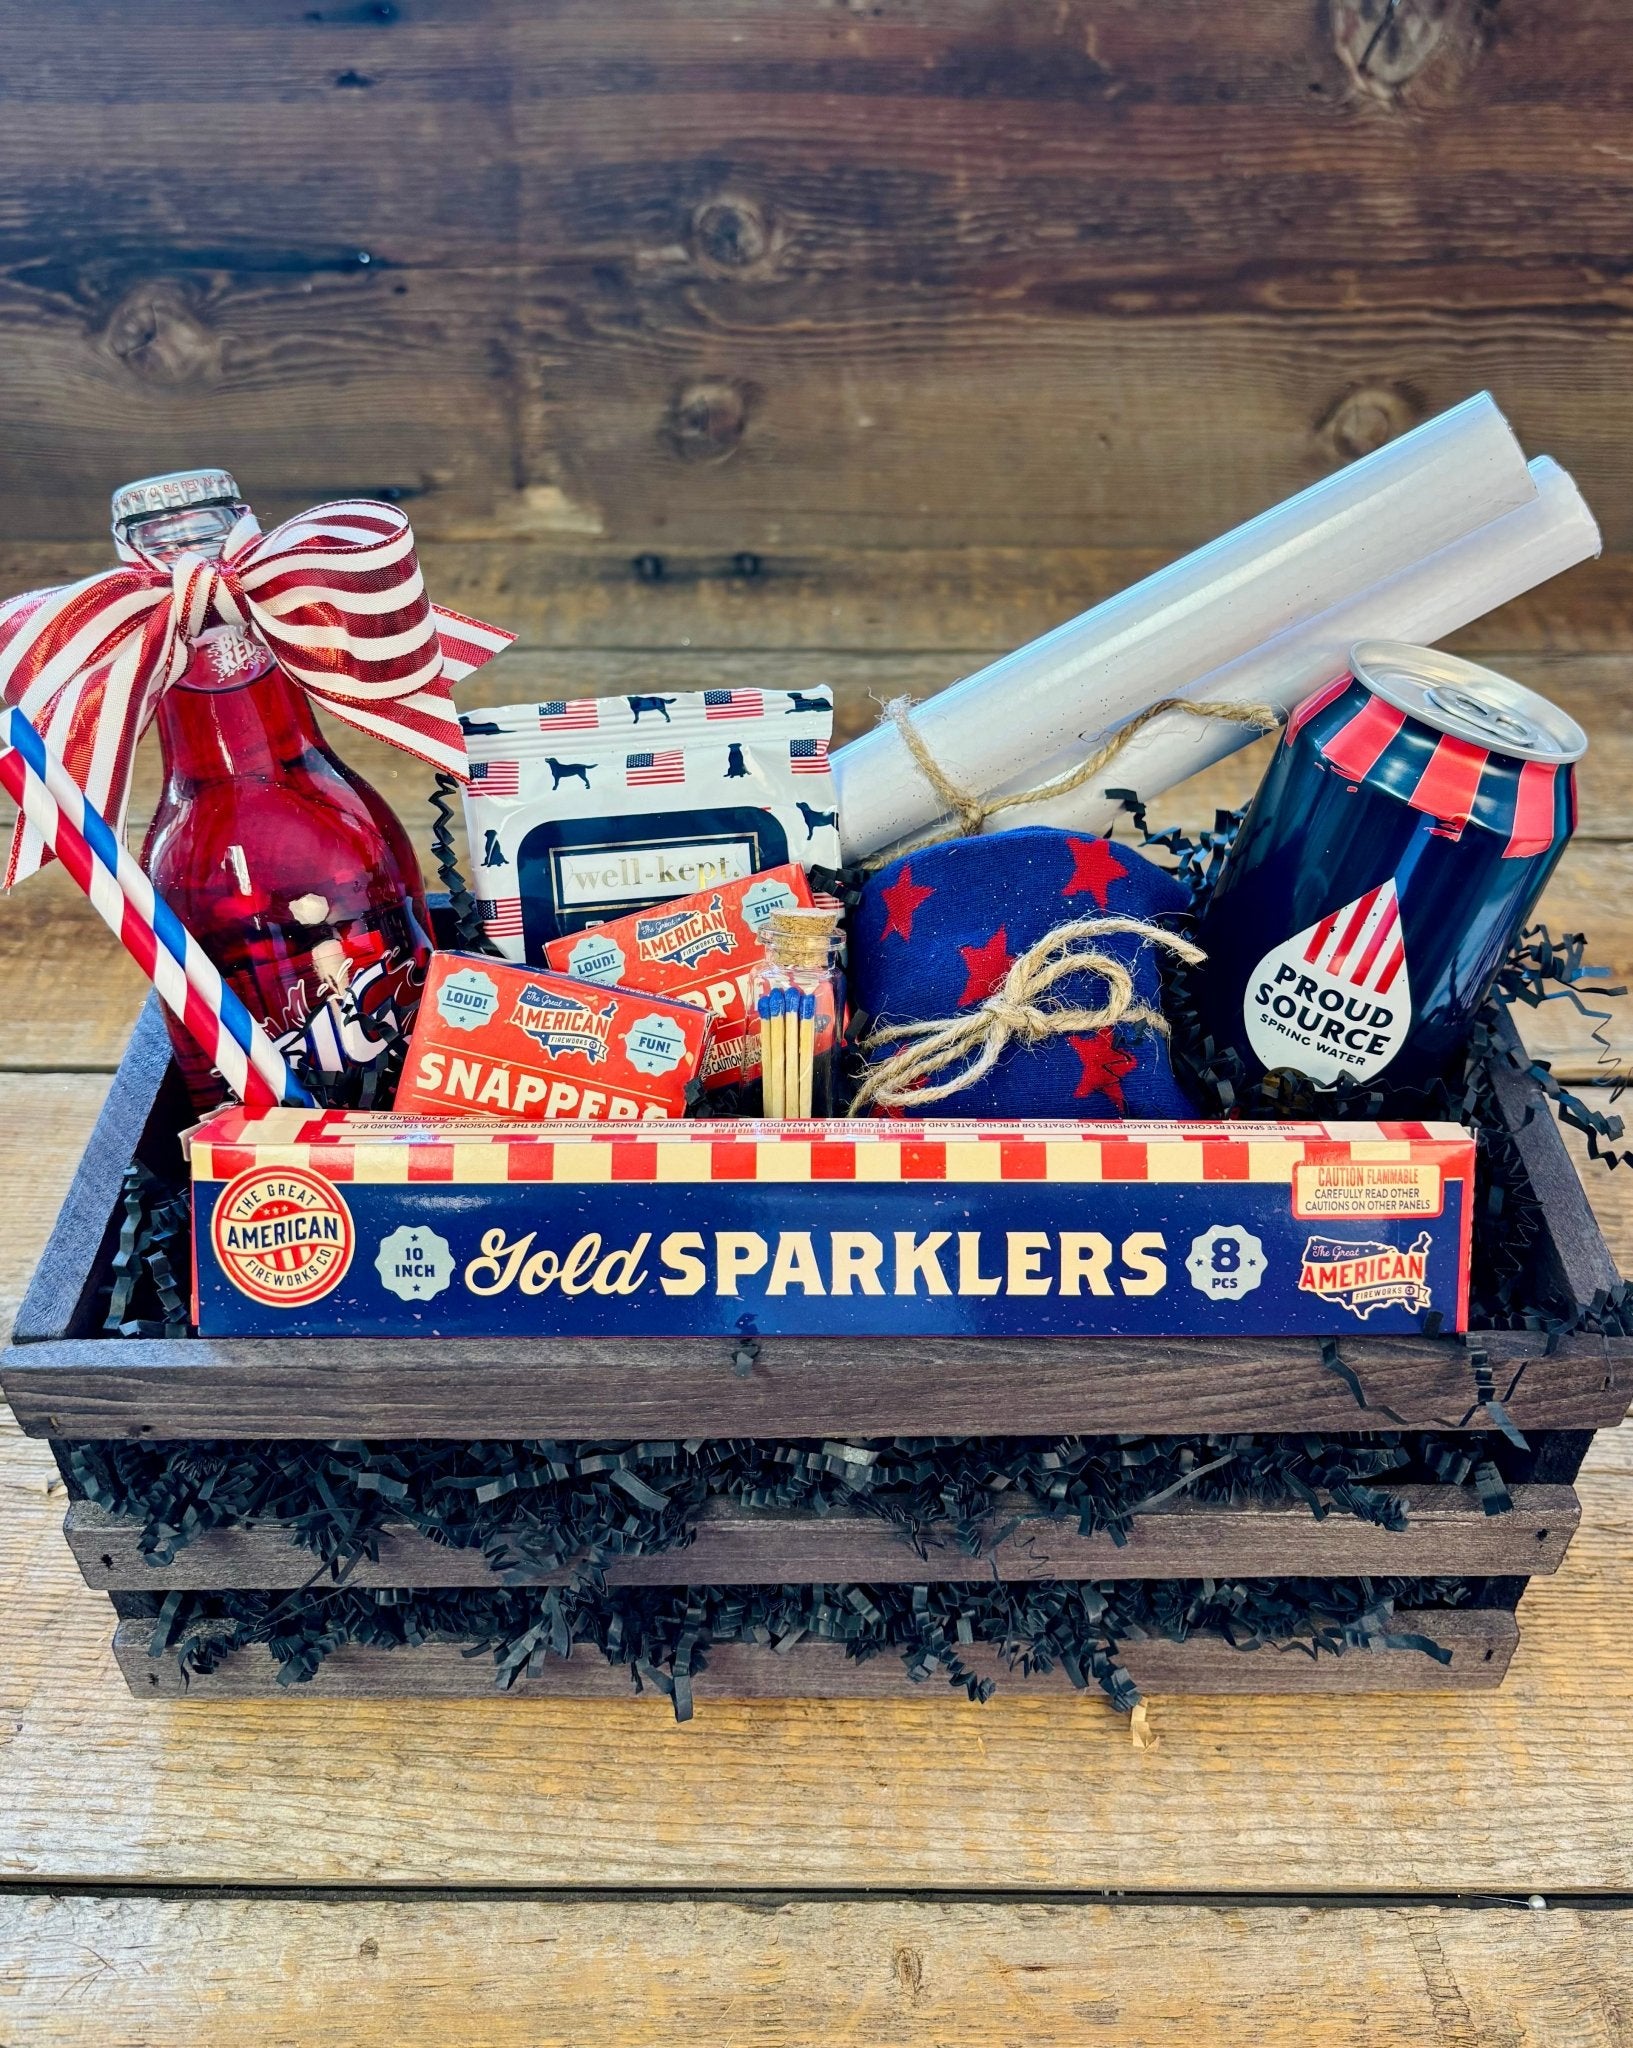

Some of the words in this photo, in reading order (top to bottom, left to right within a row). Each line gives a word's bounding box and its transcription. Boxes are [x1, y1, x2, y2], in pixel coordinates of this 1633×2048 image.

[572, 856, 740, 891] well-kept.
[754, 899, 785, 917] FUN!
[640, 911, 725, 960] AMERICAN
[641, 924, 656, 935] The
[655, 918, 675, 932] Great
[682, 937, 715, 958] FIREWORKS
[576, 954, 616, 974] LOUD!
[446, 989, 488, 1010] LOUD!
[526, 990, 540, 1002] The
[541, 994, 563, 1007] Great
[1273, 962, 1394, 1029] PROUD
[511, 1003, 609, 1039] AMERICAN
[1254, 983, 1392, 1056] SOURCE
[550, 1036, 588, 1046] FIREWORKS
[638, 1035, 671, 1053] FUN!
[1259, 1013, 1311, 1046] SPRING
[1316, 1041, 1366, 1066] WATER
[1318, 1167, 1364, 1187] CAUTION
[1367, 1168, 1419, 1185] FLAMMABLE
[236, 1190, 261, 1216] THE
[267, 1183, 317, 1206] GREAT
[1314, 1188, 1365, 1199] CAREFULLY
[1365, 1188, 1388, 1199] READ
[1390, 1188, 1420, 1198] OTHER
[1305, 1201, 1350, 1211] CAUTIONS
[1351, 1201, 1366, 1211] ON
[1367, 1200, 1397, 1210] OTHER
[1399, 1199, 1430, 1210] PANELS
[227, 1215, 338, 1249] AMERICAN
[405, 1247, 424, 1260] 10
[464, 1227, 652, 1296] Gold
[658, 1231, 1167, 1296] SPARKLERS
[1211, 1238, 1240, 1272] 8
[1312, 1245, 1330, 1257] The
[1332, 1245, 1360, 1261] Great
[245, 1259, 319, 1287] FIREWORKS
[316, 1249, 332, 1266] CO
[395, 1264, 435, 1278] INCH
[1301, 1255, 1423, 1290] AMERICAN
[1211, 1278, 1238, 1289] PCS
[1355, 1286, 1402, 1300] FIREWORKS
